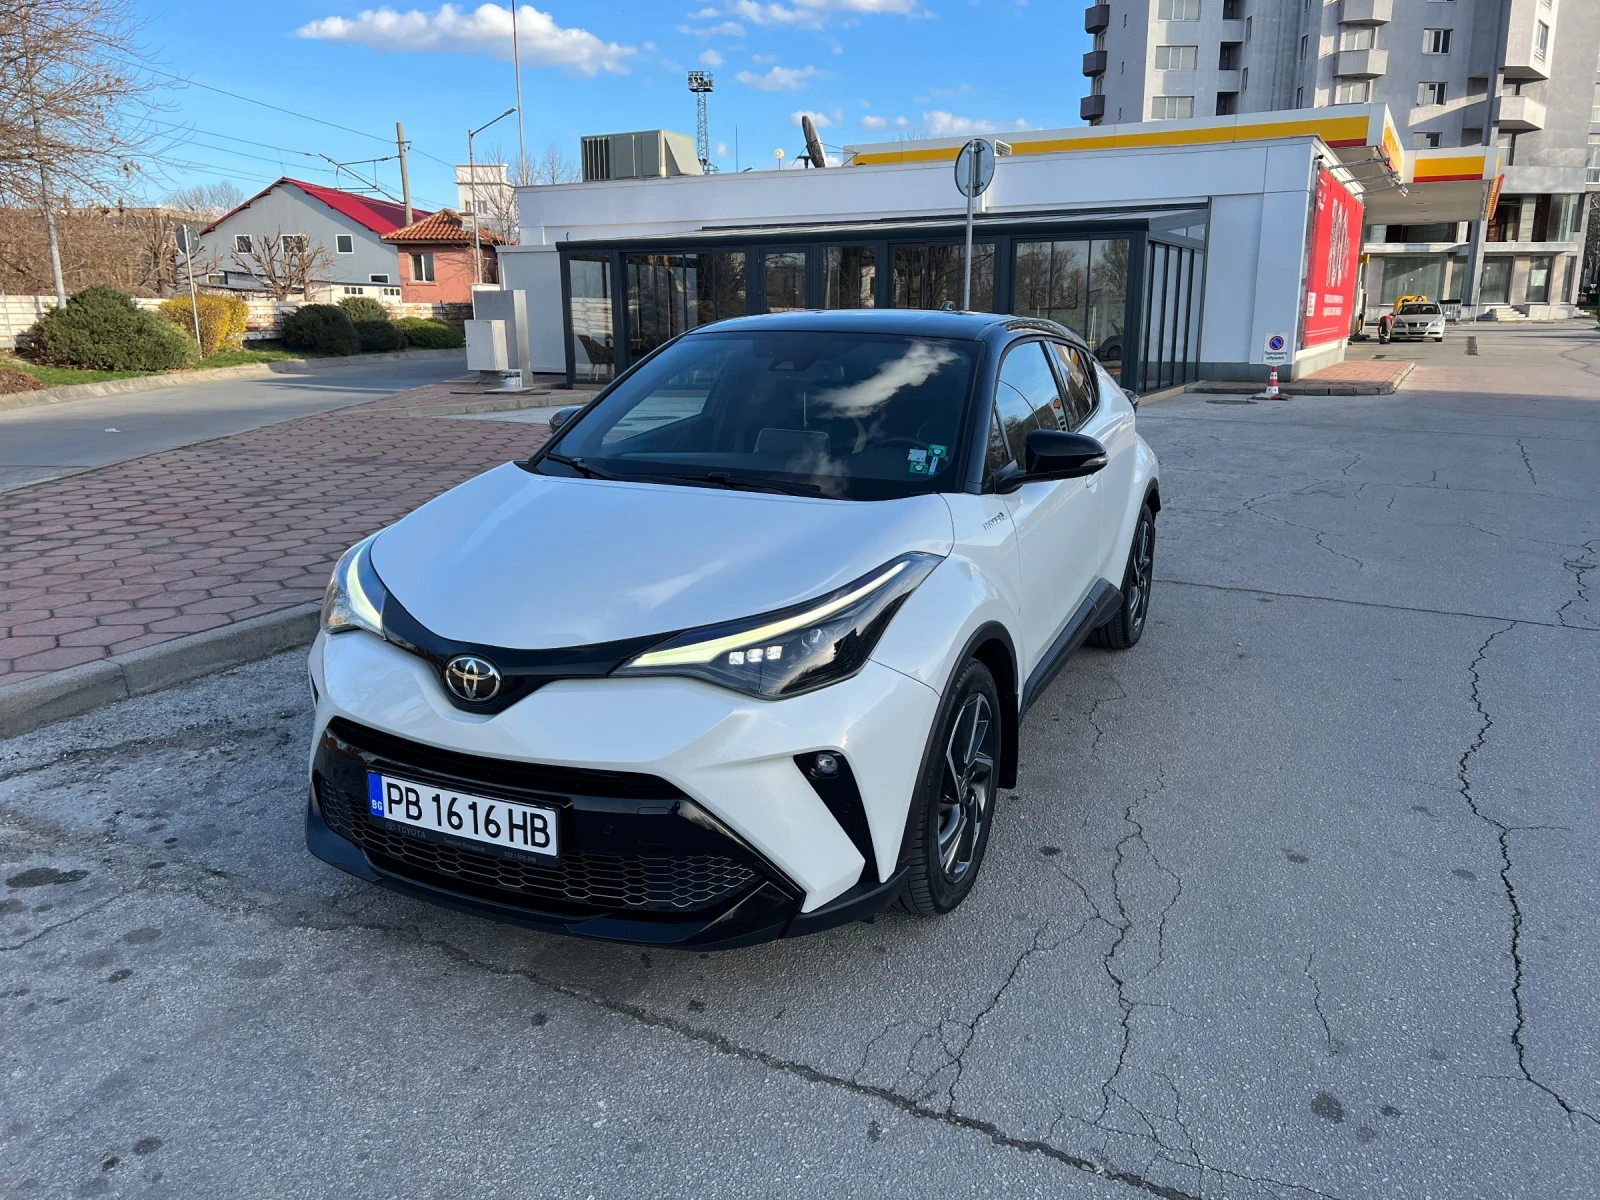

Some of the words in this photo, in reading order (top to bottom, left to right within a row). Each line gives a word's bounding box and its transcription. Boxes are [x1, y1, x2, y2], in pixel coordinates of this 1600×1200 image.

[371, 799, 383, 811] BG
[386, 782, 423, 821] PB
[432, 793, 502, 839] 1616
[508, 808, 551, 849] HB
[397, 825, 426, 839] TOYOTA
